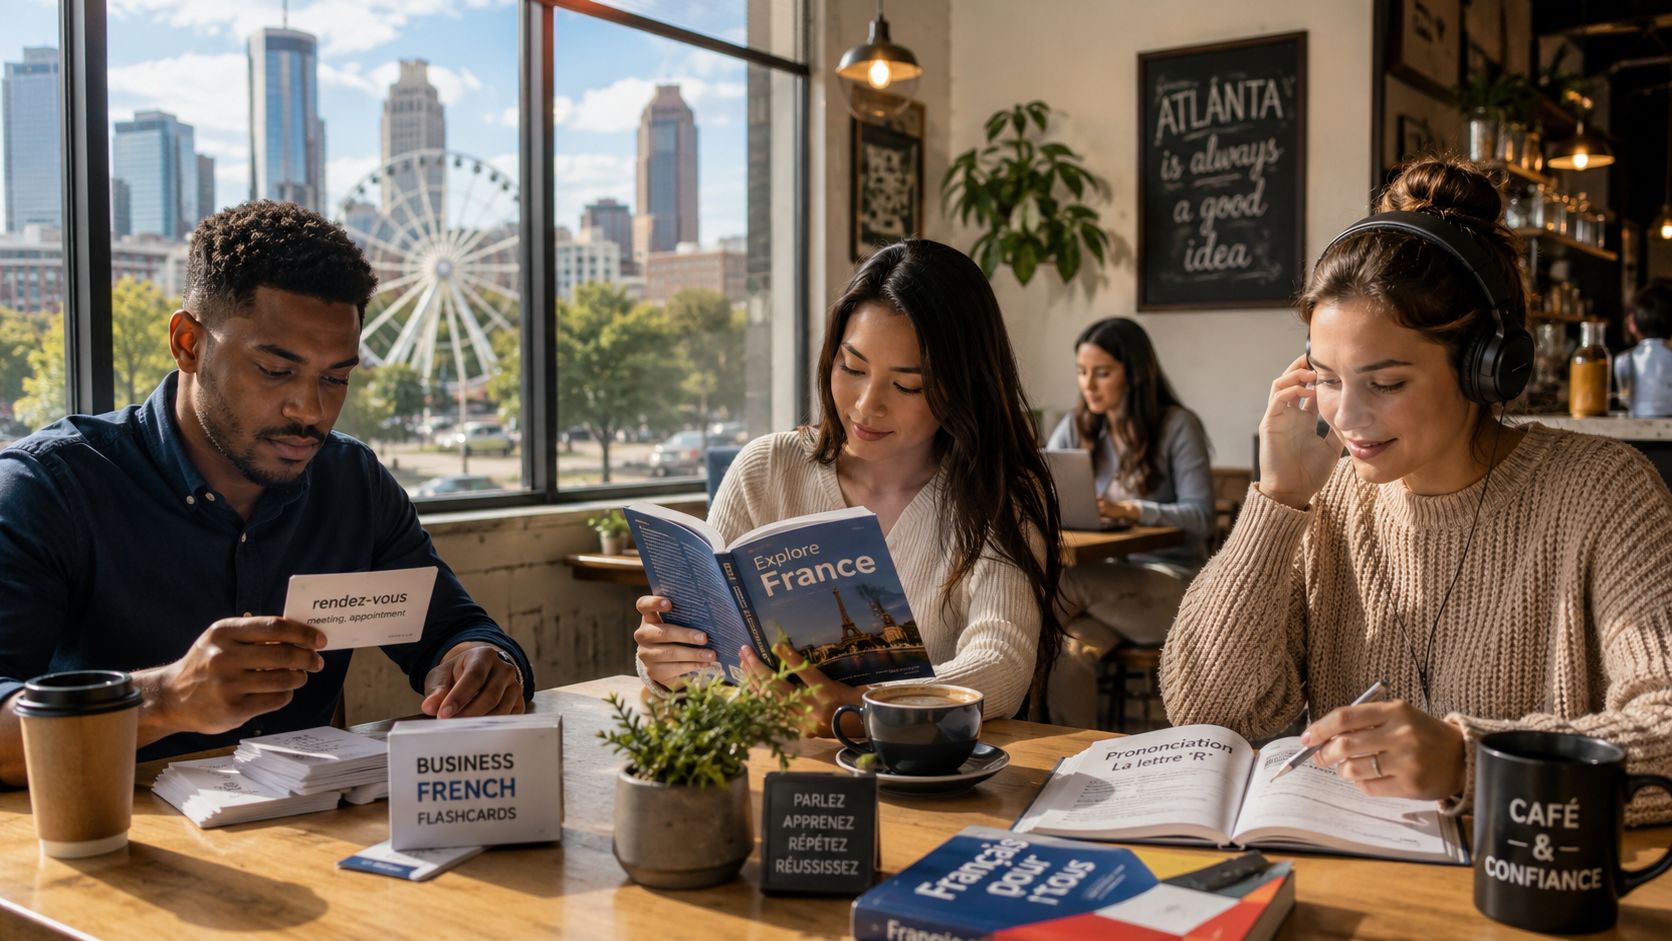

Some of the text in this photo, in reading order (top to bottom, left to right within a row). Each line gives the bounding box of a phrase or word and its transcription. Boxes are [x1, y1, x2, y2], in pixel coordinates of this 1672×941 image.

[1160, 134, 1280, 181] is always
[1173, 177, 1267, 236] a good
[1183, 231, 1252, 273] idea
[753, 543, 820, 571] Explore
[760, 555, 877, 597] France
[312, 592, 408, 610] rendez-vous
[306, 609, 406, 625] meeting, appointment
[1105, 738, 1233, 761] Prononciation
[416, 753, 514, 774] BUSINESS
[1111, 763, 1132, 772] La
[1137, 756, 1183, 768] lettre
[416, 777, 516, 802] FRENCH
[793, 793, 845, 808] PARLEZ
[417, 807, 517, 825] FLASHCARDS
[782, 814, 855, 830] APPRENEZ
[1509, 797, 1580, 829] CAFÉ
[788, 833, 848, 852] RÉPÉTEZ
[1532, 833, 1554, 862] &
[775, 856, 859, 875] RÉUSSISSEZ
[914, 838, 1029, 901] Français
[986, 854, 1051, 898] pour
[1484, 855, 1603, 891] CONFIANCE
